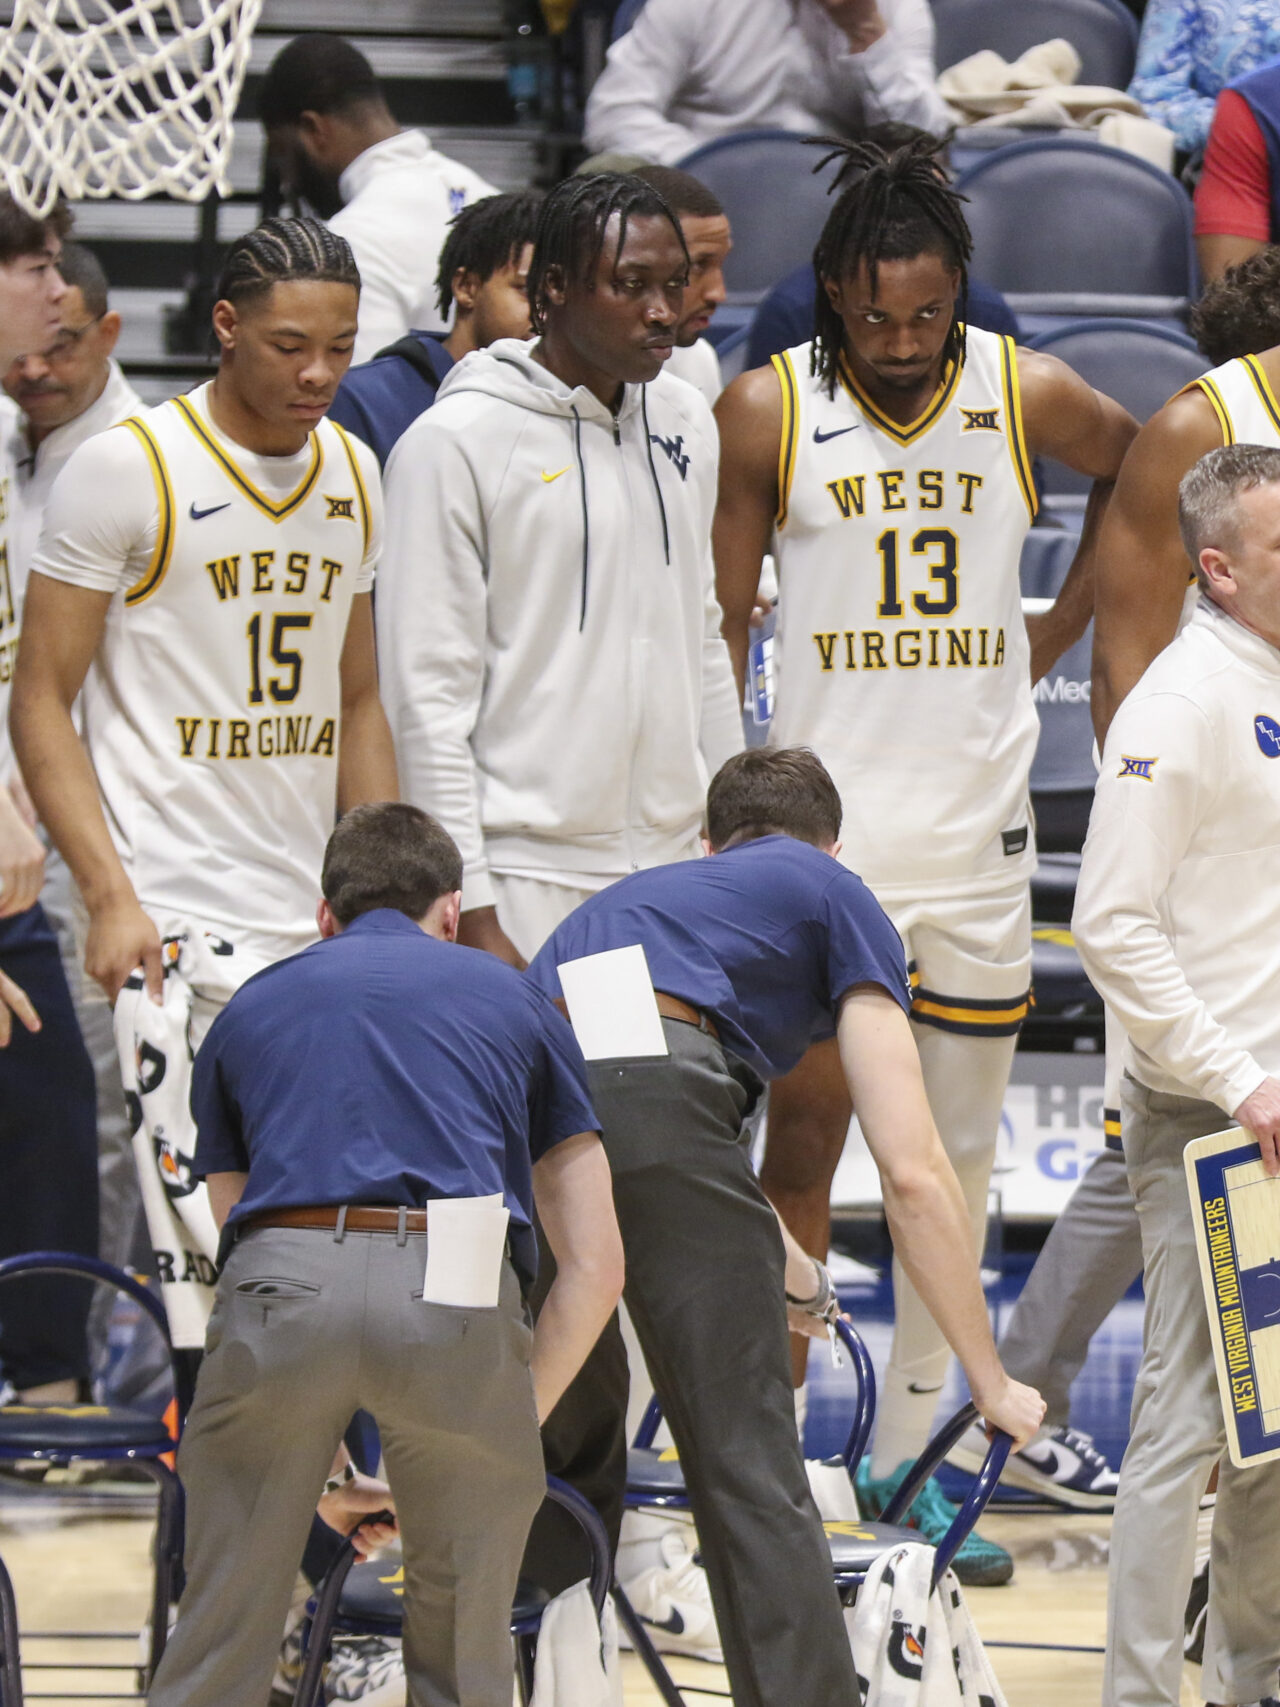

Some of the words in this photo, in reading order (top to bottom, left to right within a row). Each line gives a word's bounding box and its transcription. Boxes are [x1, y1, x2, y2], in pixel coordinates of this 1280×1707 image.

[826, 468, 984, 520] WEST
[206, 549, 343, 603] WEST
[876, 526, 960, 619] 13
[245, 611, 315, 708] 15
[813, 626, 1005, 670] VIRGINIA
[176, 714, 336, 759] VIRGINIA
[1204, 1197, 1240, 1308] MOUNTAINEERS
[1221, 1307, 1250, 1370] VIRGINIA
[1231, 1374, 1257, 1414] WEST
